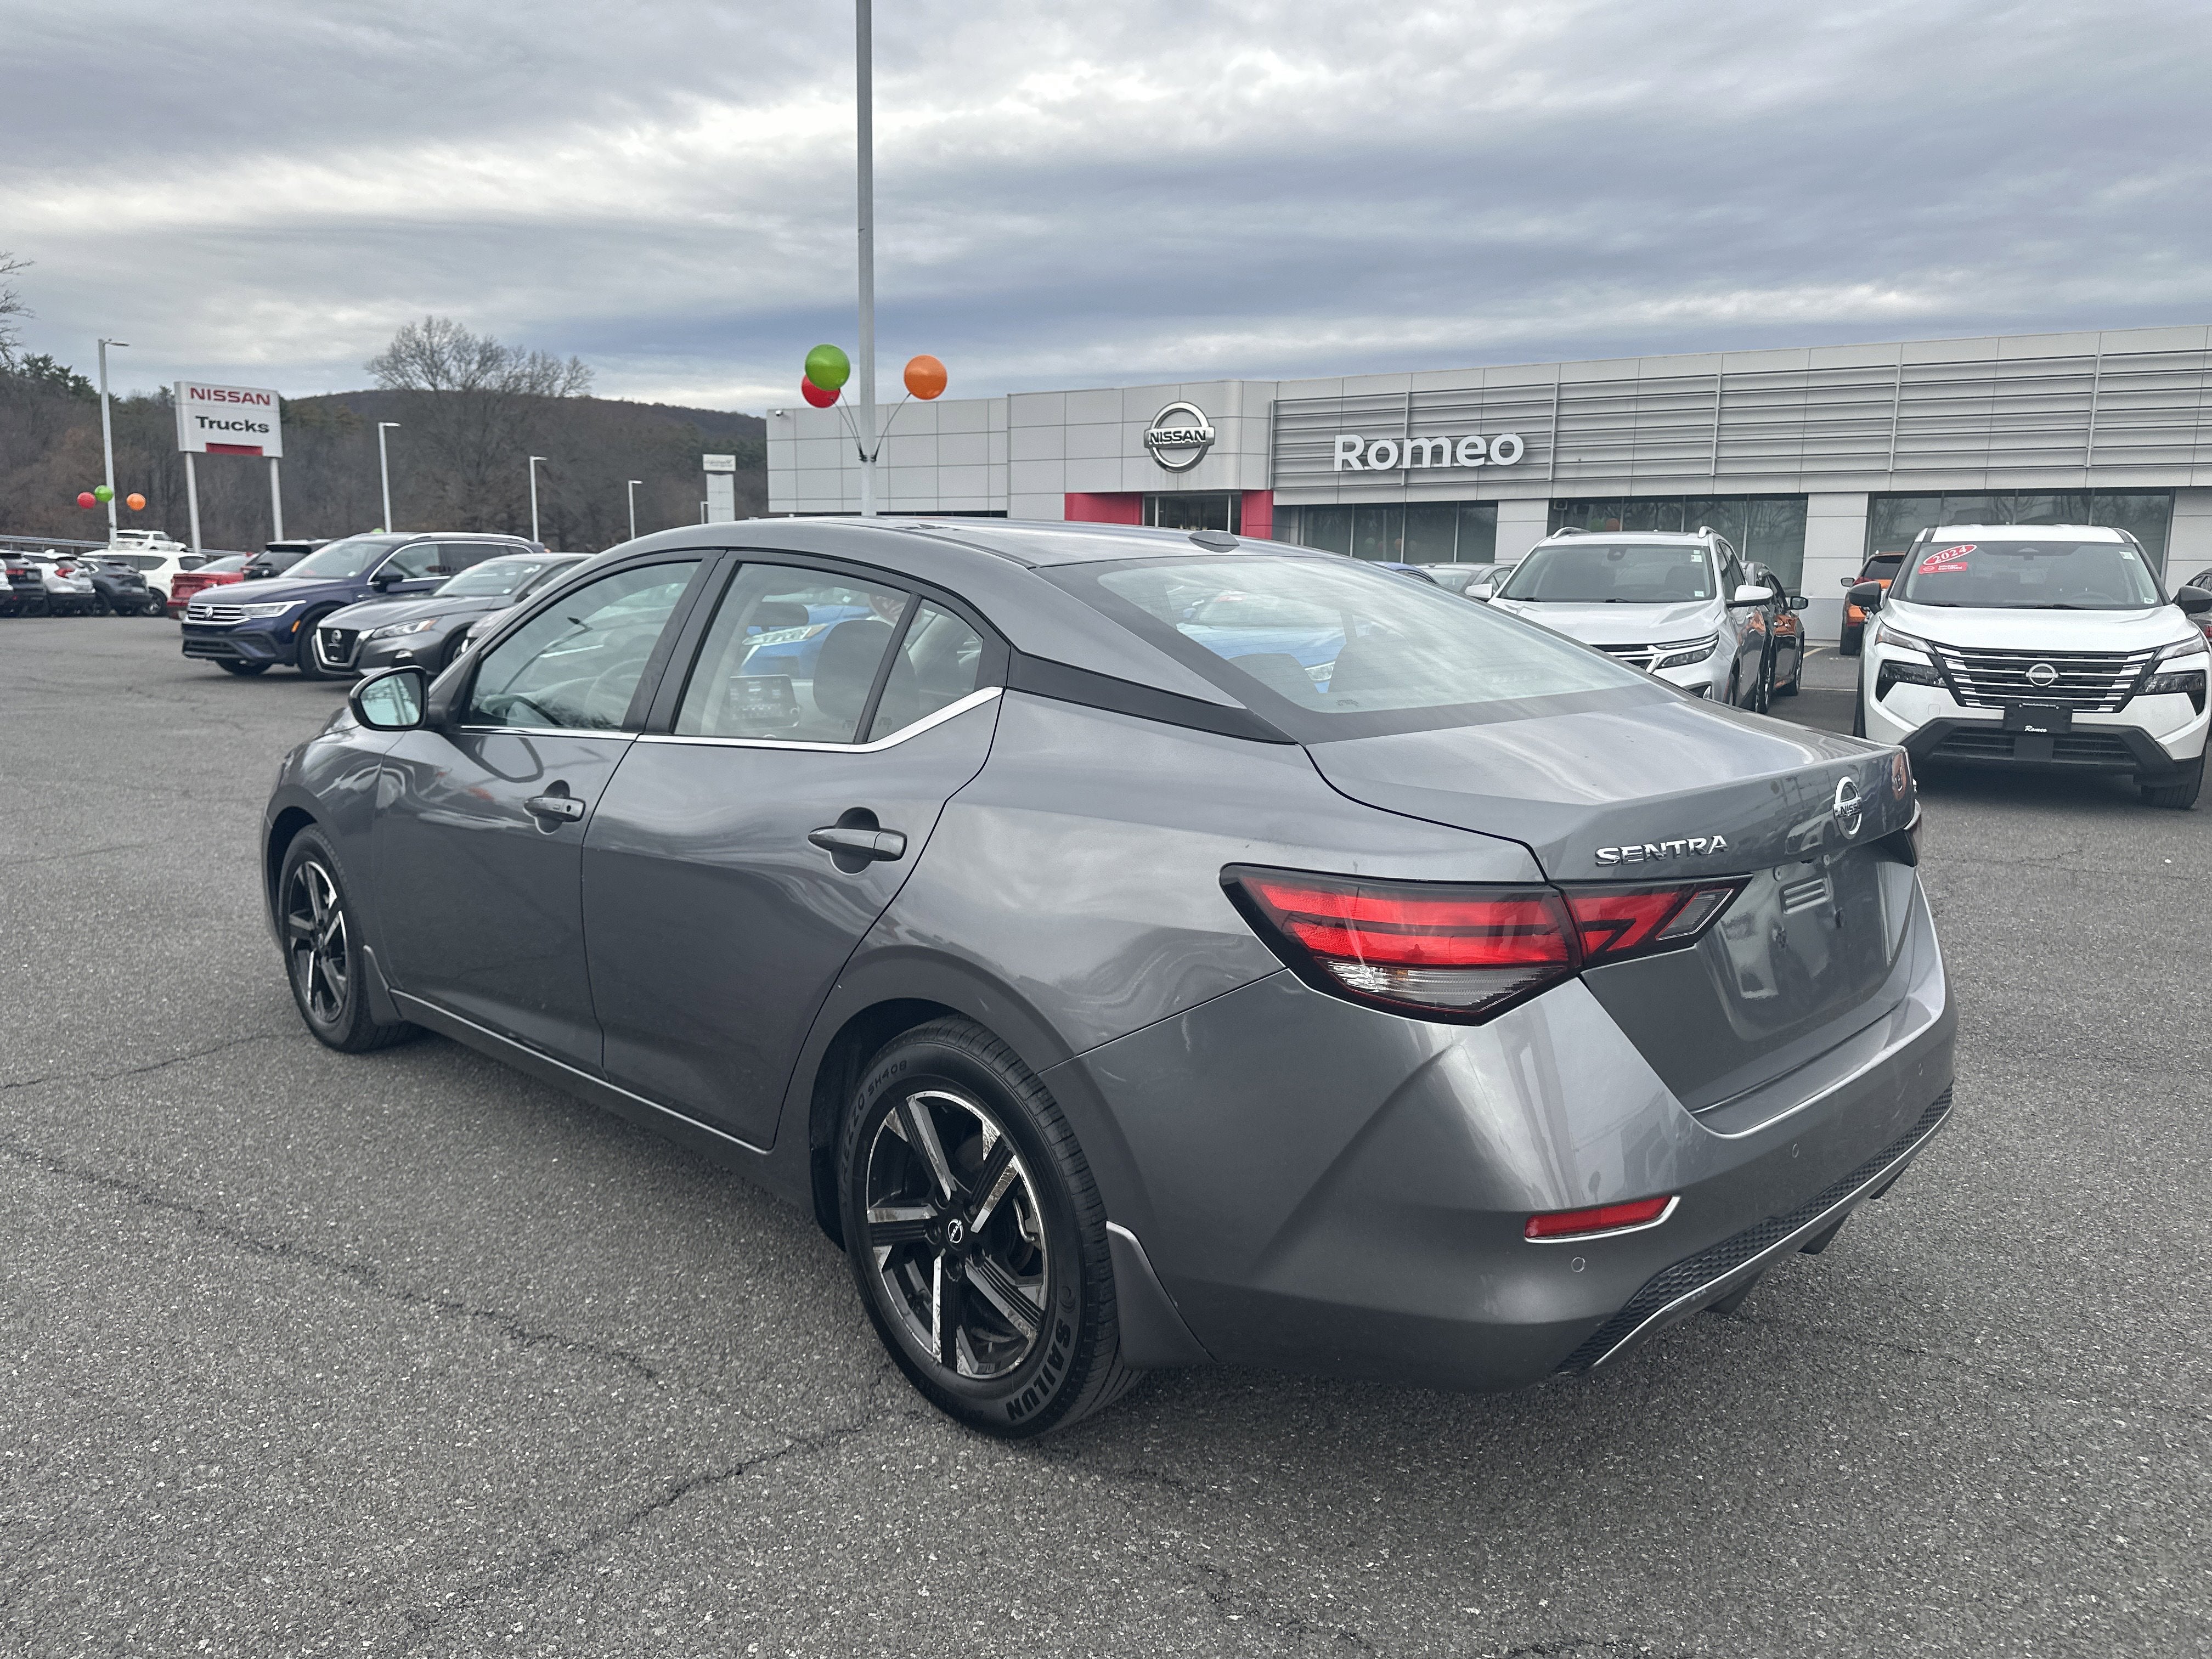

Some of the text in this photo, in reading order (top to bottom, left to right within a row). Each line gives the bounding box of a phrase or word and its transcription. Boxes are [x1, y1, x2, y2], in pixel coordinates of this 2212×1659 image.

[190, 387, 270, 406] NISSAN
[195, 415, 269, 433] Trucks
[1149, 430, 1206, 444] NISSAN
[1334, 434, 1524, 471] Romeo
[1933, 546, 1967, 563] 2024
[1840, 801, 1862, 815] NISS
[1595, 835, 1728, 866] SENTRA
[867, 1060, 907, 1097] SH408
[1006, 1318, 1071, 1421] SAILUN
